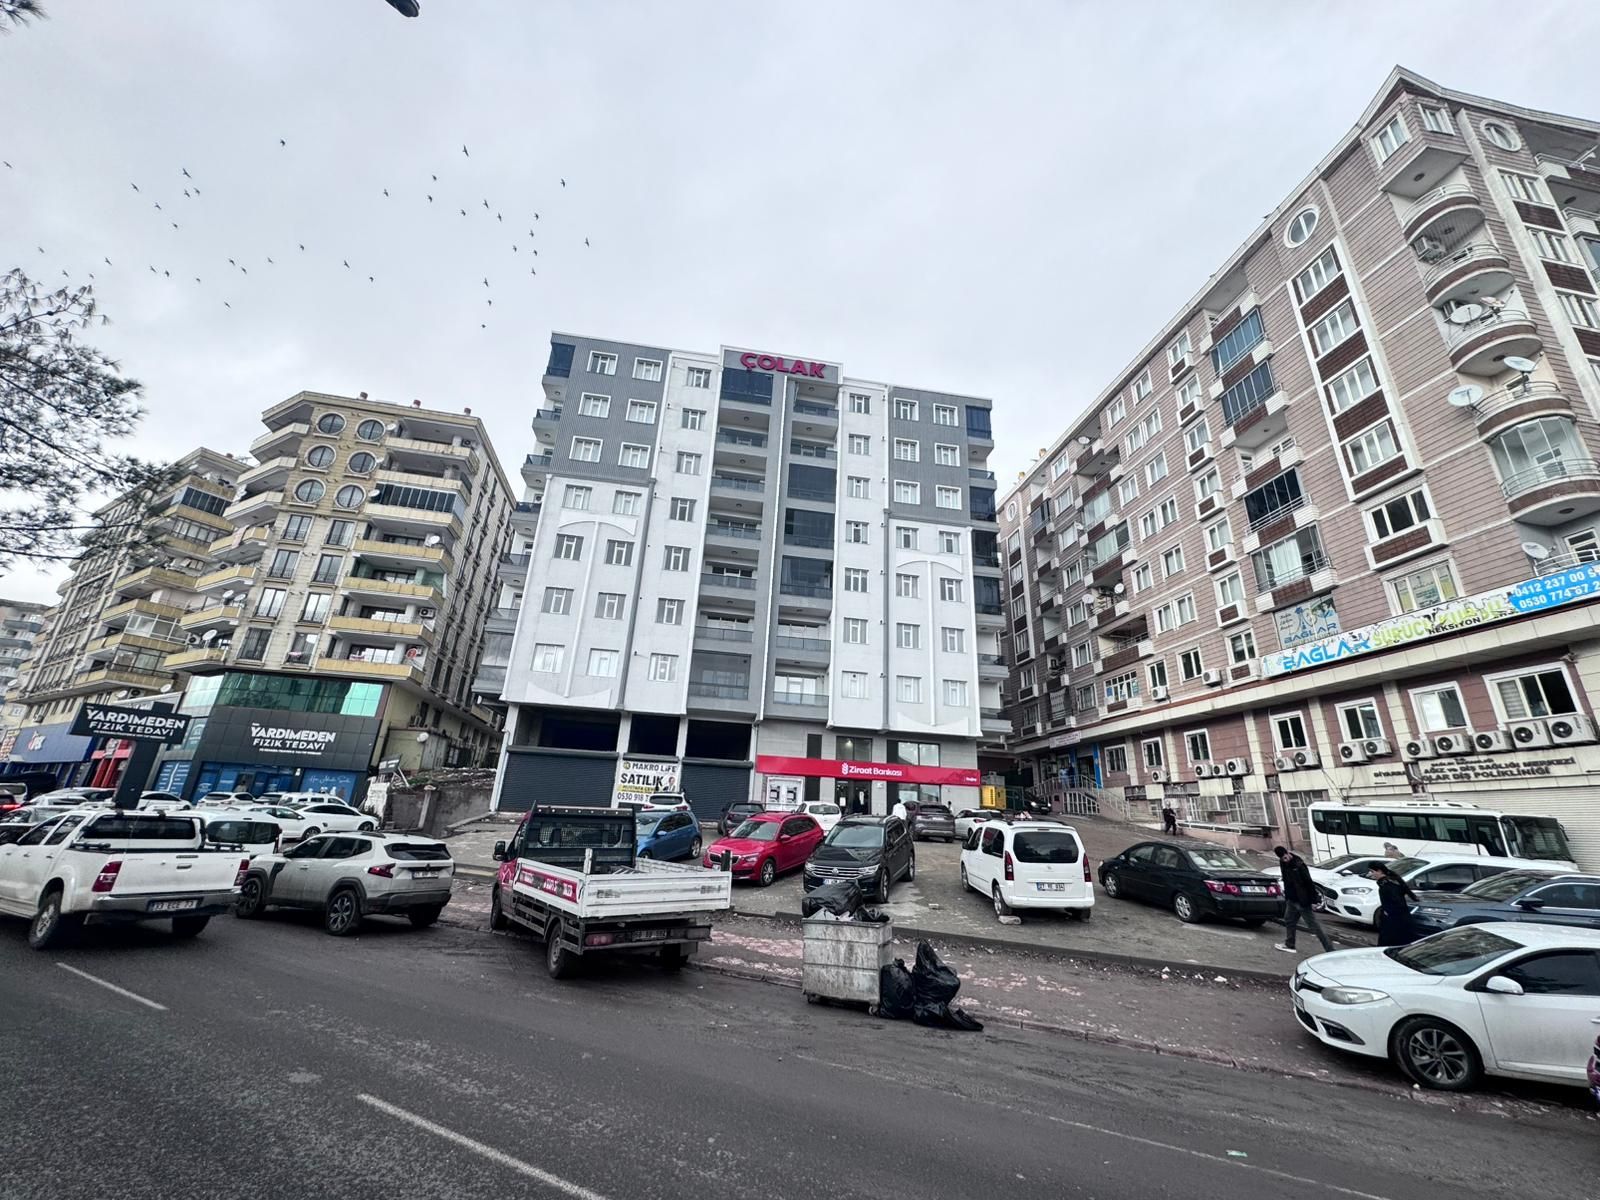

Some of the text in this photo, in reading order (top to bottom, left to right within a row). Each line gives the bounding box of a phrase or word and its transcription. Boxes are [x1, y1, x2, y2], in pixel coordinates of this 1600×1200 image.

[740, 352, 826, 379] ÇOLAK
[1515, 583, 1542, 598] 0412
[1544, 576, 1566, 590] 237
[1569, 571, 1585, 583] 00
[1519, 595, 1547, 609] 0530
[1549, 587, 1572, 602] 774
[1574, 583, 1589, 595] 67
[86, 709, 185, 729] YARDIMEDEN
[251, 726, 336, 743] YARDIMEDEN
[632, 763, 659, 772] MAKRO
[849, 766, 902, 777] Ziraat Bankası
[620, 773, 664, 787] SATILIK
[617, 792, 633, 801] 0530
